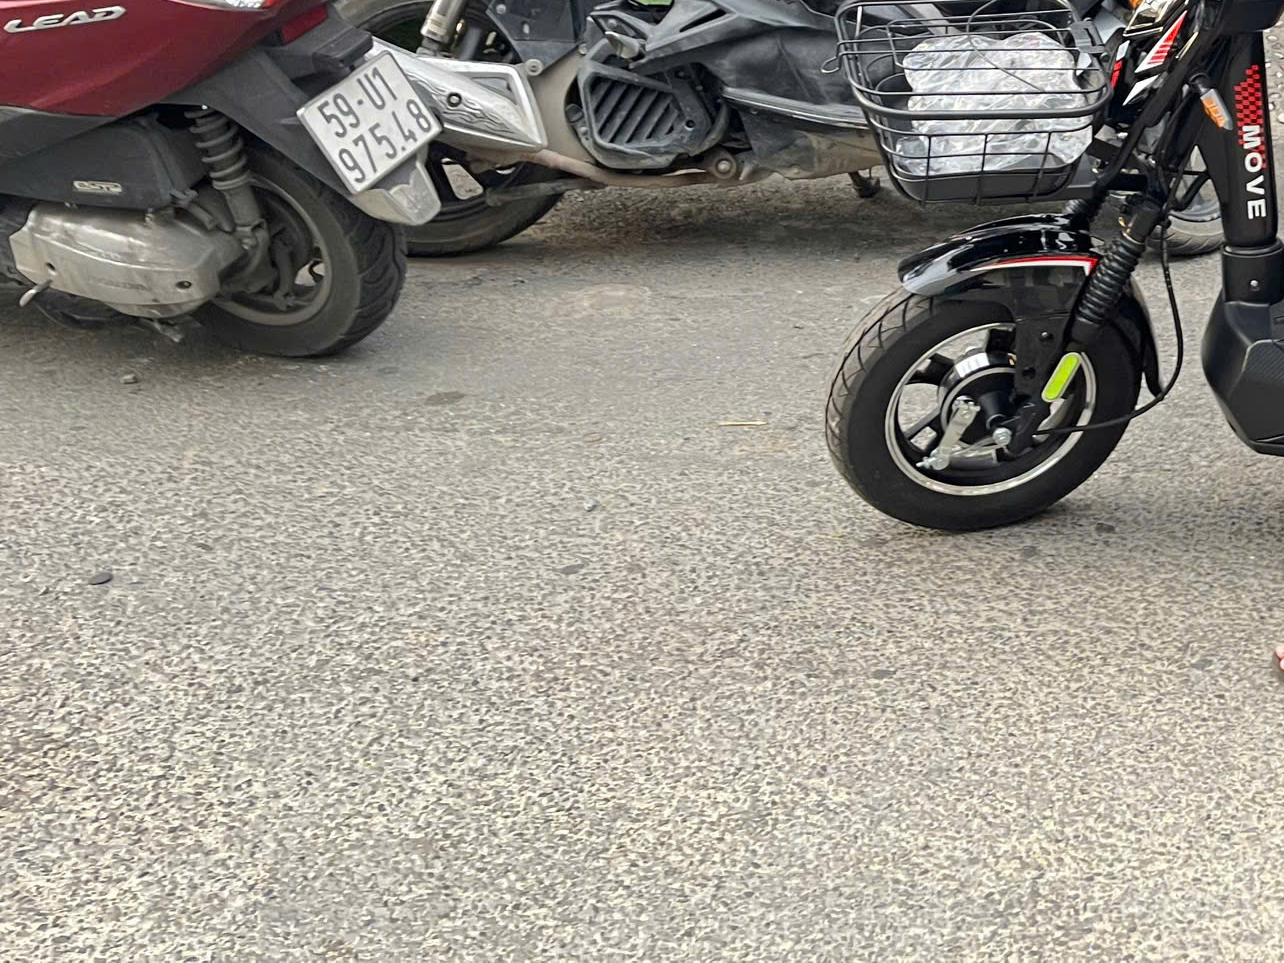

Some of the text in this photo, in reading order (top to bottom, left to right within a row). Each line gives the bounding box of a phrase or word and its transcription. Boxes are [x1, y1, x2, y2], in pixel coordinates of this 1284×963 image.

[3, 6, 127, 33] LEAD
[338, 99, 432, 183] 975.48
[1241, 125, 1267, 220] MOVE
